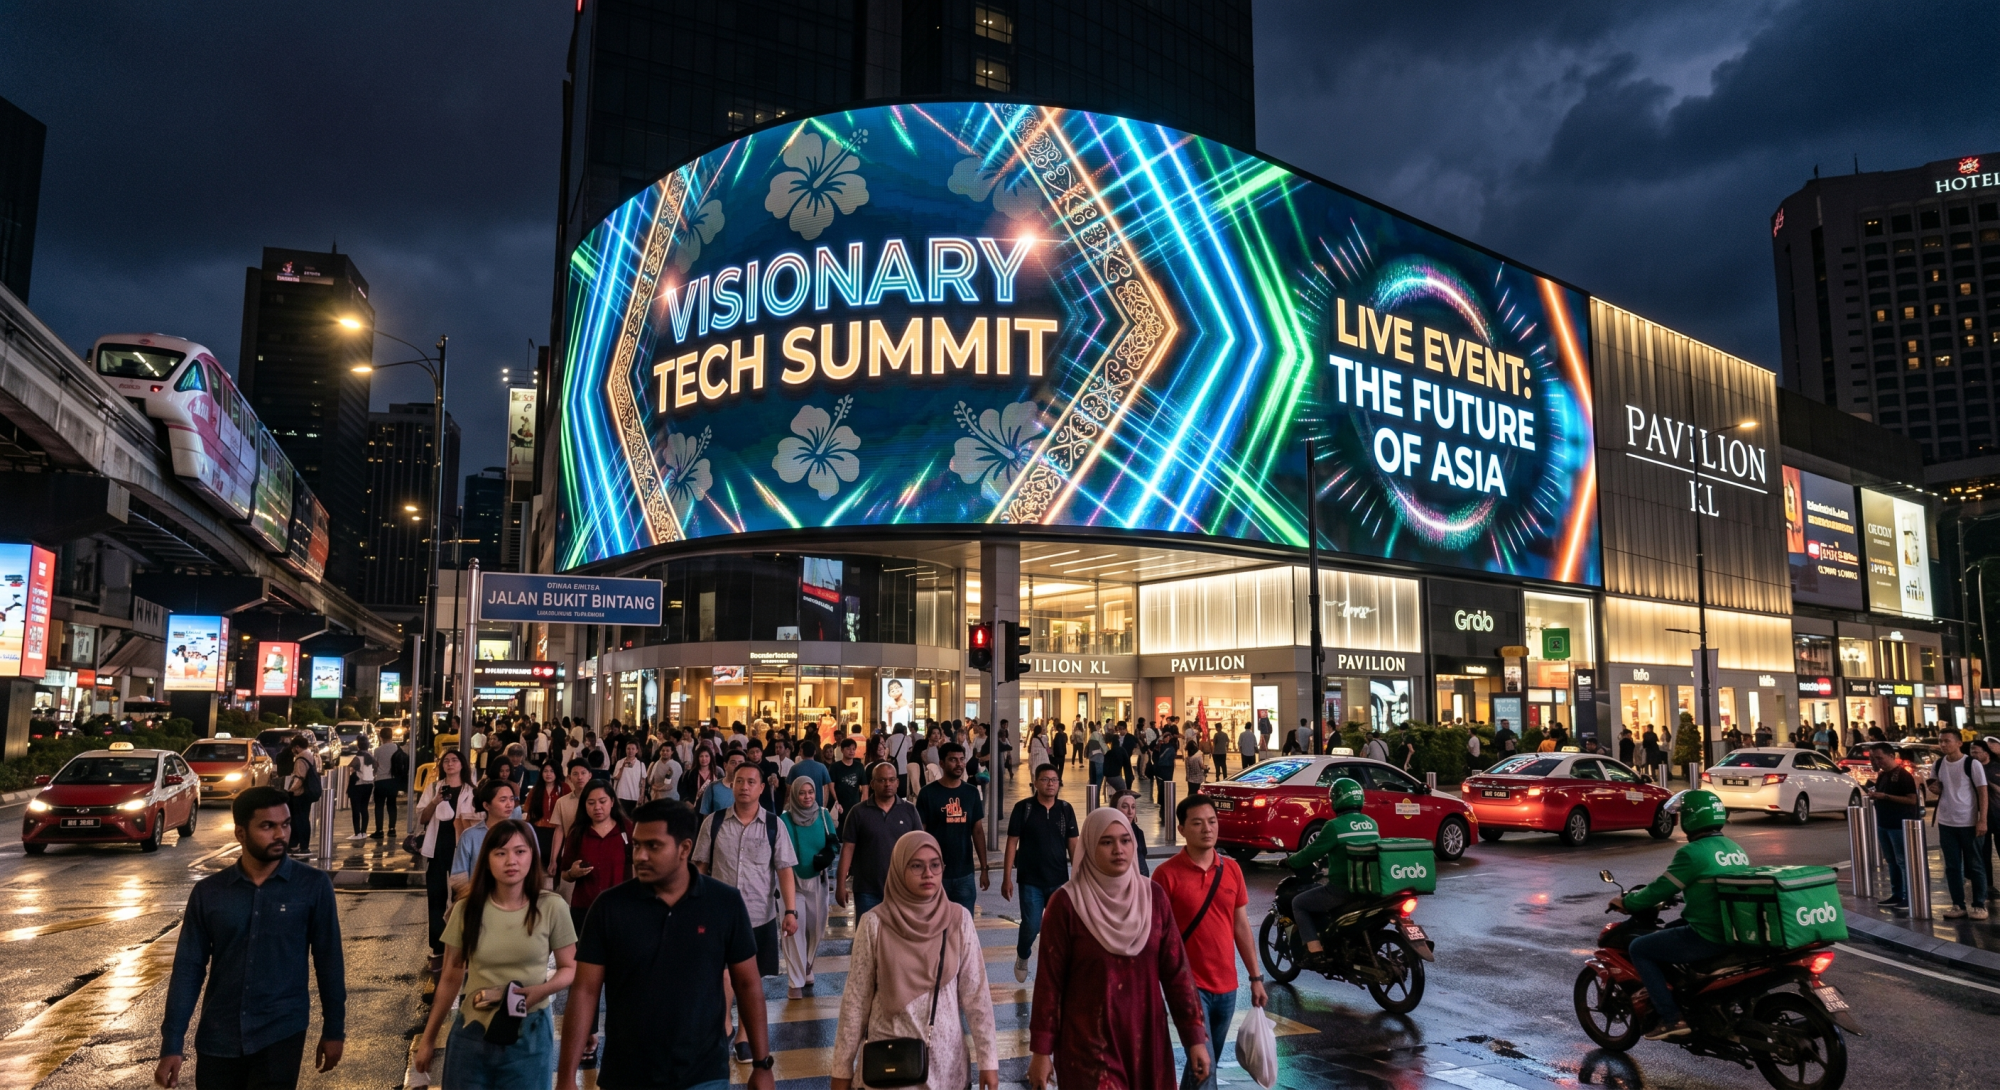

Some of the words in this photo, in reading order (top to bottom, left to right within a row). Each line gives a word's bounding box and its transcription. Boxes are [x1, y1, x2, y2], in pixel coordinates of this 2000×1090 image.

[1935, 172, 2000, 193] HOTEL
[667, 237, 1037, 343] VISIONARY
[1337, 298, 1414, 363] LIVE
[1424, 327, 1532, 400] EVENT:
[654, 334, 764, 413] TECH
[781, 317, 1057, 384] SUMMIT
[1329, 354, 1402, 417] THE
[1413, 378, 1536, 450] FUTURE
[1373, 427, 1421, 476] OF
[1431, 441, 1507, 496] ASIA
[488, 590, 538, 606] JALAN
[543, 592, 588, 608] BUKIT
[592, 594, 655, 610] BINTANG
[1090, 660, 1110, 674] KL
[1171, 654, 1245, 673] PAVILION
[1337, 654, 1406, 671] PAVILION
[1390, 862, 1427, 879] Grab
[1796, 901, 1837, 926] Grab
